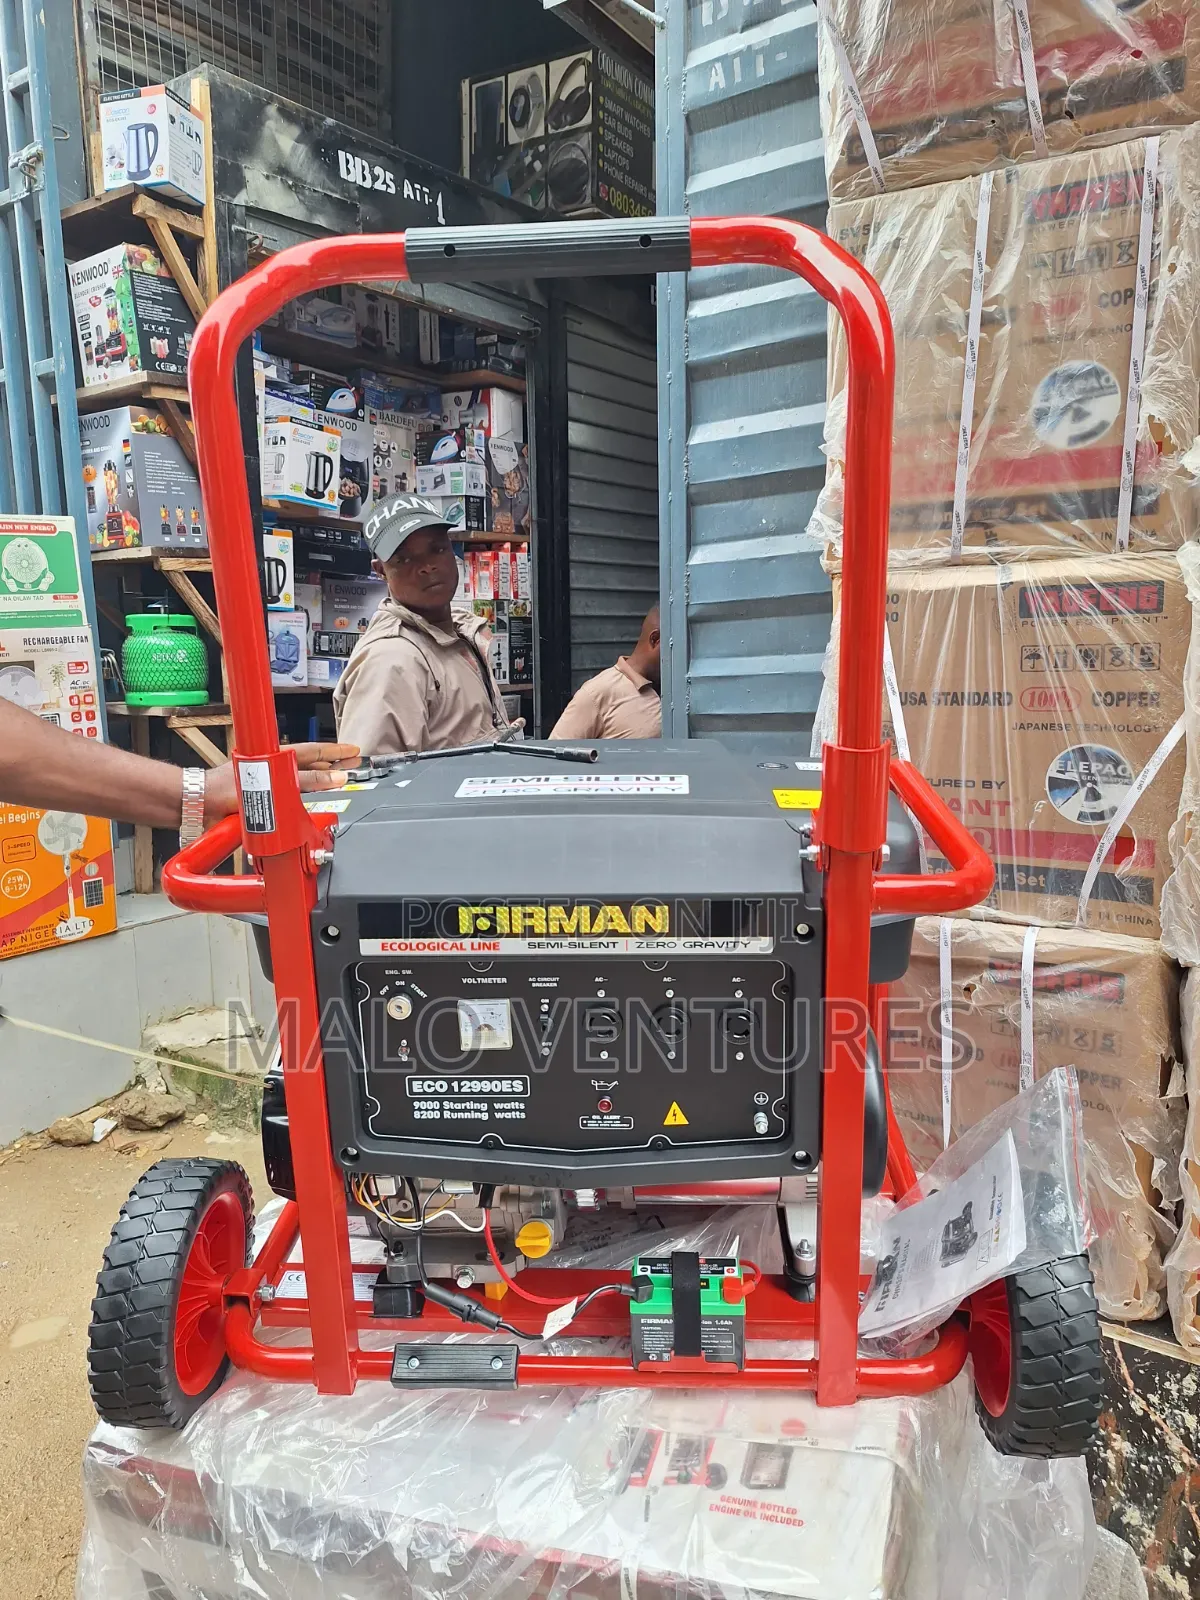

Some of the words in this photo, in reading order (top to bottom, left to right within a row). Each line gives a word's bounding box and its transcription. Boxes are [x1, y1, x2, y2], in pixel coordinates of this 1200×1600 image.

[604, 96, 624, 119] SMART
[624, 111, 651, 138] WATCHES
[604, 112, 616, 129] EAR
[616, 121, 633, 140] BUDS
[604, 129, 634, 158] SPEAKERS
[604, 145, 630, 171] LAPTOPS
[338, 149, 396, 195] BB25
[604, 161, 624, 183] PHONE
[71, 261, 109, 288] KENWOOD
[314, 412, 358, 432] KENWOOD
[23, 636, 75, 646] RECHARGEABLE
[76, 635, 89, 643] FAN
[900, 691, 928, 707] USA
[932, 691, 1013, 707] STANDARD
[1091, 691, 1161, 708] COPPER
[1012, 721, 1071, 732] JAPANESE
[981, 780, 1006, 790] BY
[8, 810, 41, 824] Begins
[7, 875, 24, 884] 25W
[1015, 871, 1046, 887] Set
[457, 905, 670, 935] FIRMAN
[1116, 913, 1154, 927] CHINA
[20, 922, 71, 944] NIGERIA
[75, 919, 95, 931] LTD
[380, 942, 467, 952] ECOLOGICAL
[470, 942, 501, 951] LINE
[527, 941, 619, 950] SEMI-SILENT
[635, 940, 678, 949] ZERO
[682, 940, 751, 949] GRAVITY
[379, 985, 390, 996] OFF
[410, 983, 428, 999] START
[412, 1080, 448, 1092] ECO
[451, 1080, 524, 1092] 12990ES
[413, 1101, 441, 1110] 9000
[443, 1100, 488, 1111] Starting
[493, 1101, 525, 1110] watts
[413, 1110, 441, 1119] 8200
[443, 1110, 489, 1120] Running
[494, 1110, 526, 1119] watts
[720, 1495, 758, 1508] GENUINE
[759, 1502, 798, 1515] BOTTLED
[709, 1503, 742, 1517] ENGINE
[743, 1509, 758, 1519] OIL
[760, 1512, 804, 1527] INCLUDED
